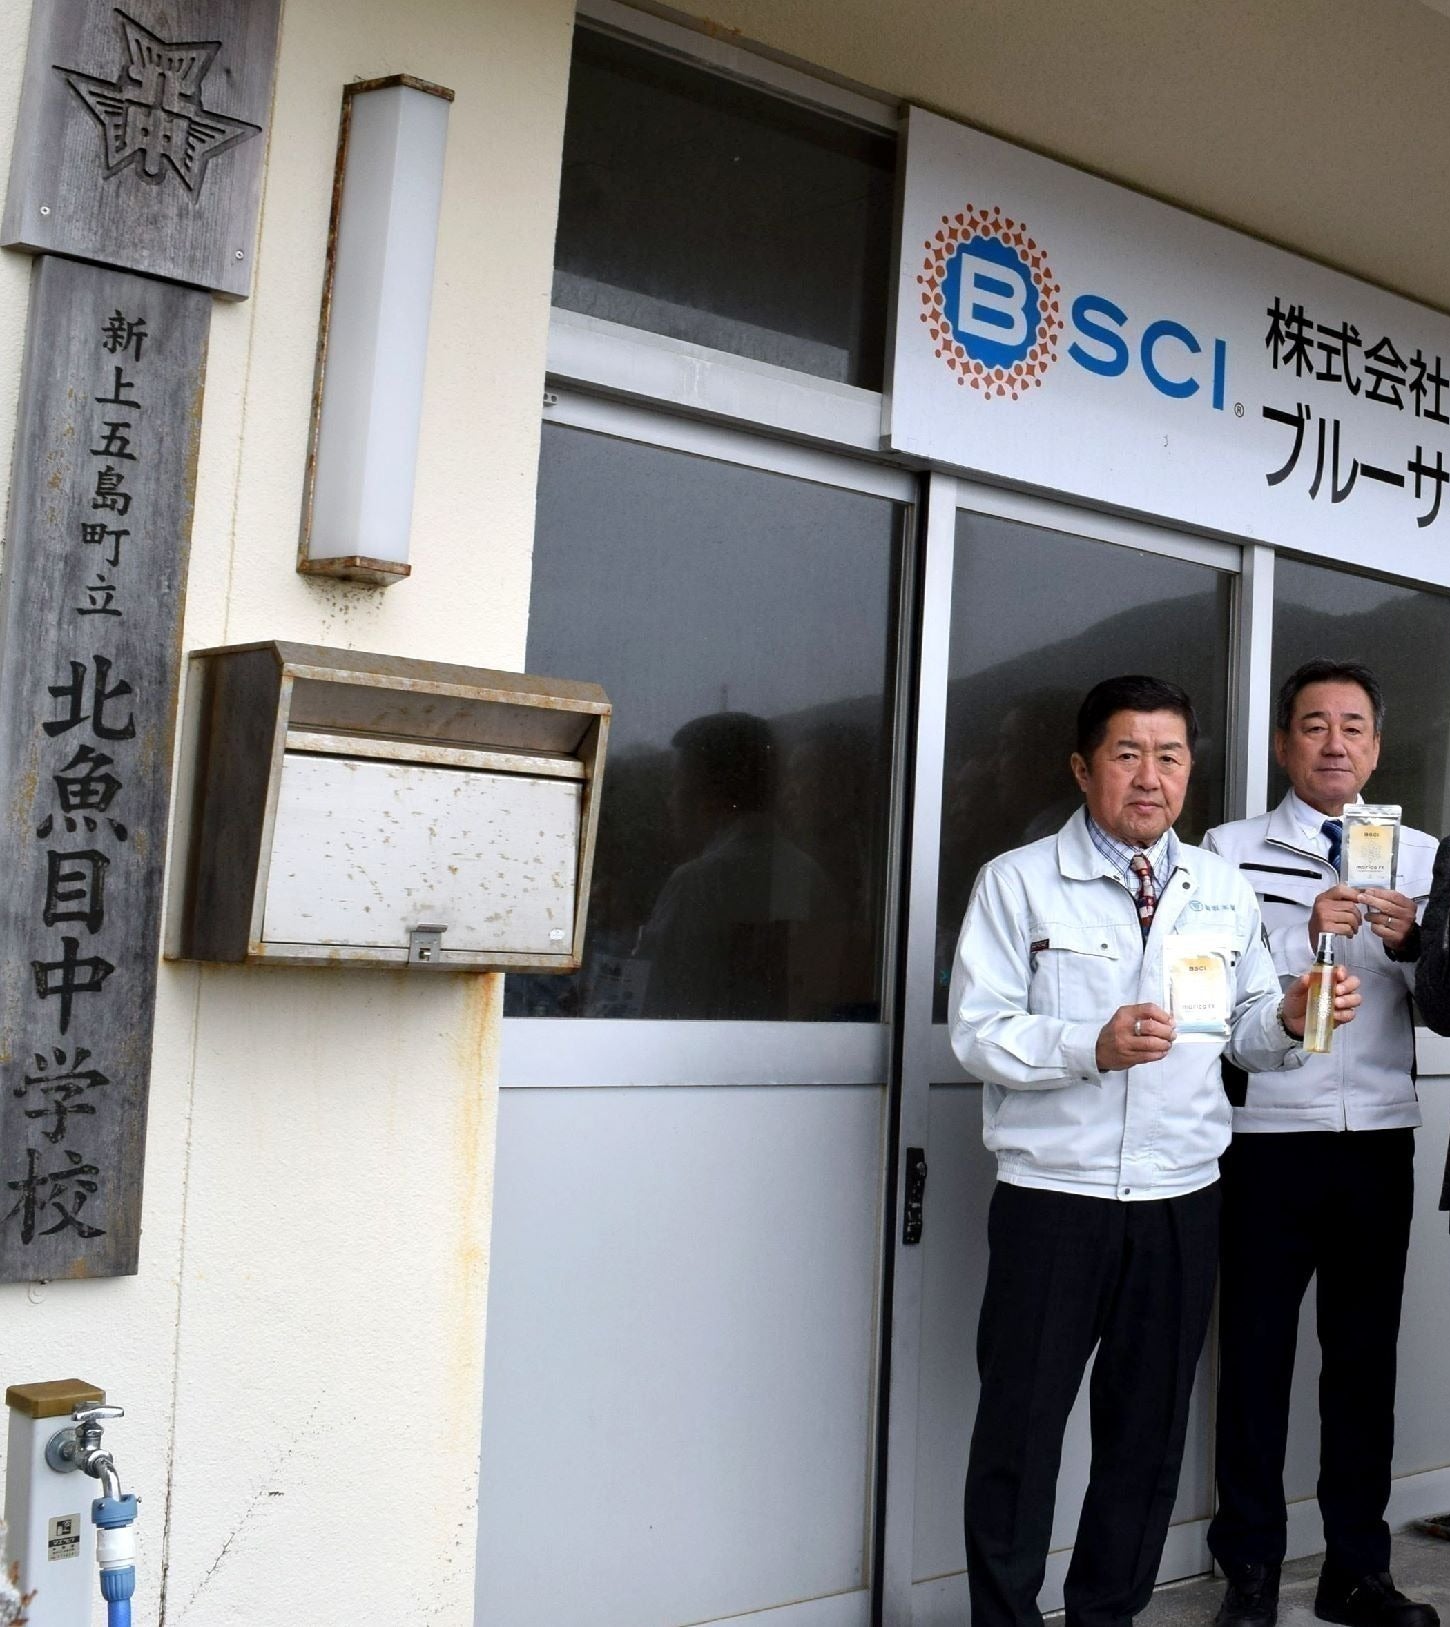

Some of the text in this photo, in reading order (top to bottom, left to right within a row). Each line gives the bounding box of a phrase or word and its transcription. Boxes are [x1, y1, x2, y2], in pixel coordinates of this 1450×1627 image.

[1264, 296, 1450, 426] 株式会社
[1, 309, 149, 1245] 新上五島町立 北魚目中学校
